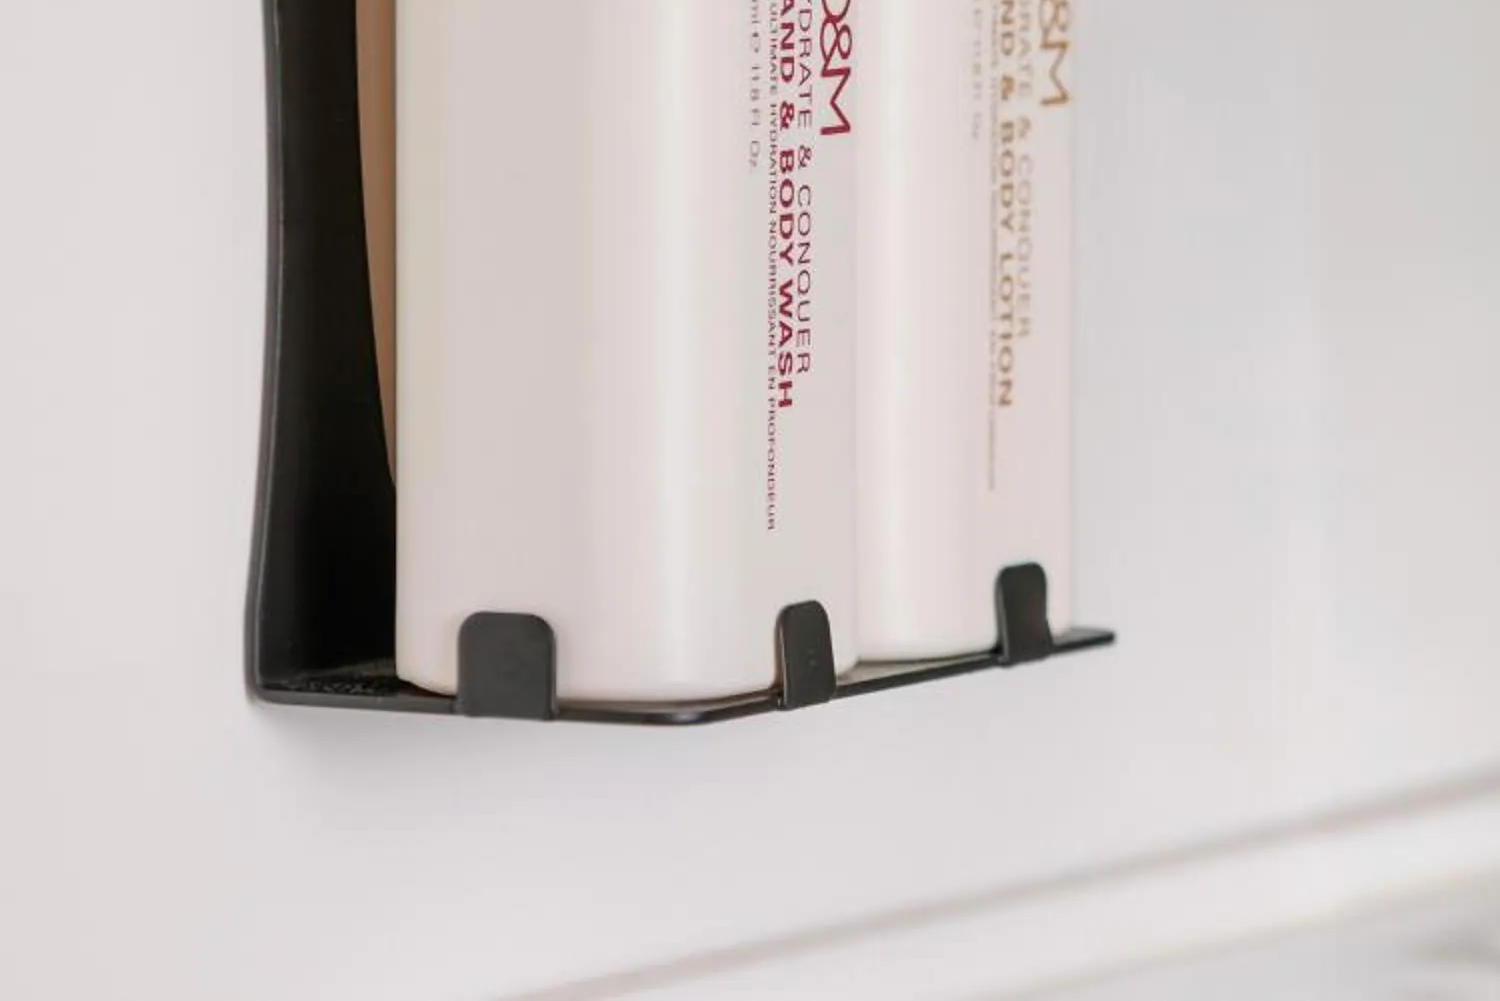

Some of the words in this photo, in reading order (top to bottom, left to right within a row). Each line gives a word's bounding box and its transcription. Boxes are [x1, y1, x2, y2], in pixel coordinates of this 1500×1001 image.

[769, 2, 779, 97] ULTIMATE
[1001, 75, 1015, 102] &
[768, 103, 779, 215] HYDRATION
[780, 100, 795, 131] &
[798, 144, 813, 170] &
[1019, 116, 1032, 140] &
[779, 149, 795, 267] BODY
[1000, 121, 1014, 234] BODY
[767, 220, 778, 357] NOURRISSANT
[797, 184, 812, 375] CONQUER
[1018, 154, 1032, 339] CONQUER
[778, 278, 793, 409] WASH
[999, 252, 1013, 408] LOTION
[766, 397, 778, 531] PROFONDEUR
